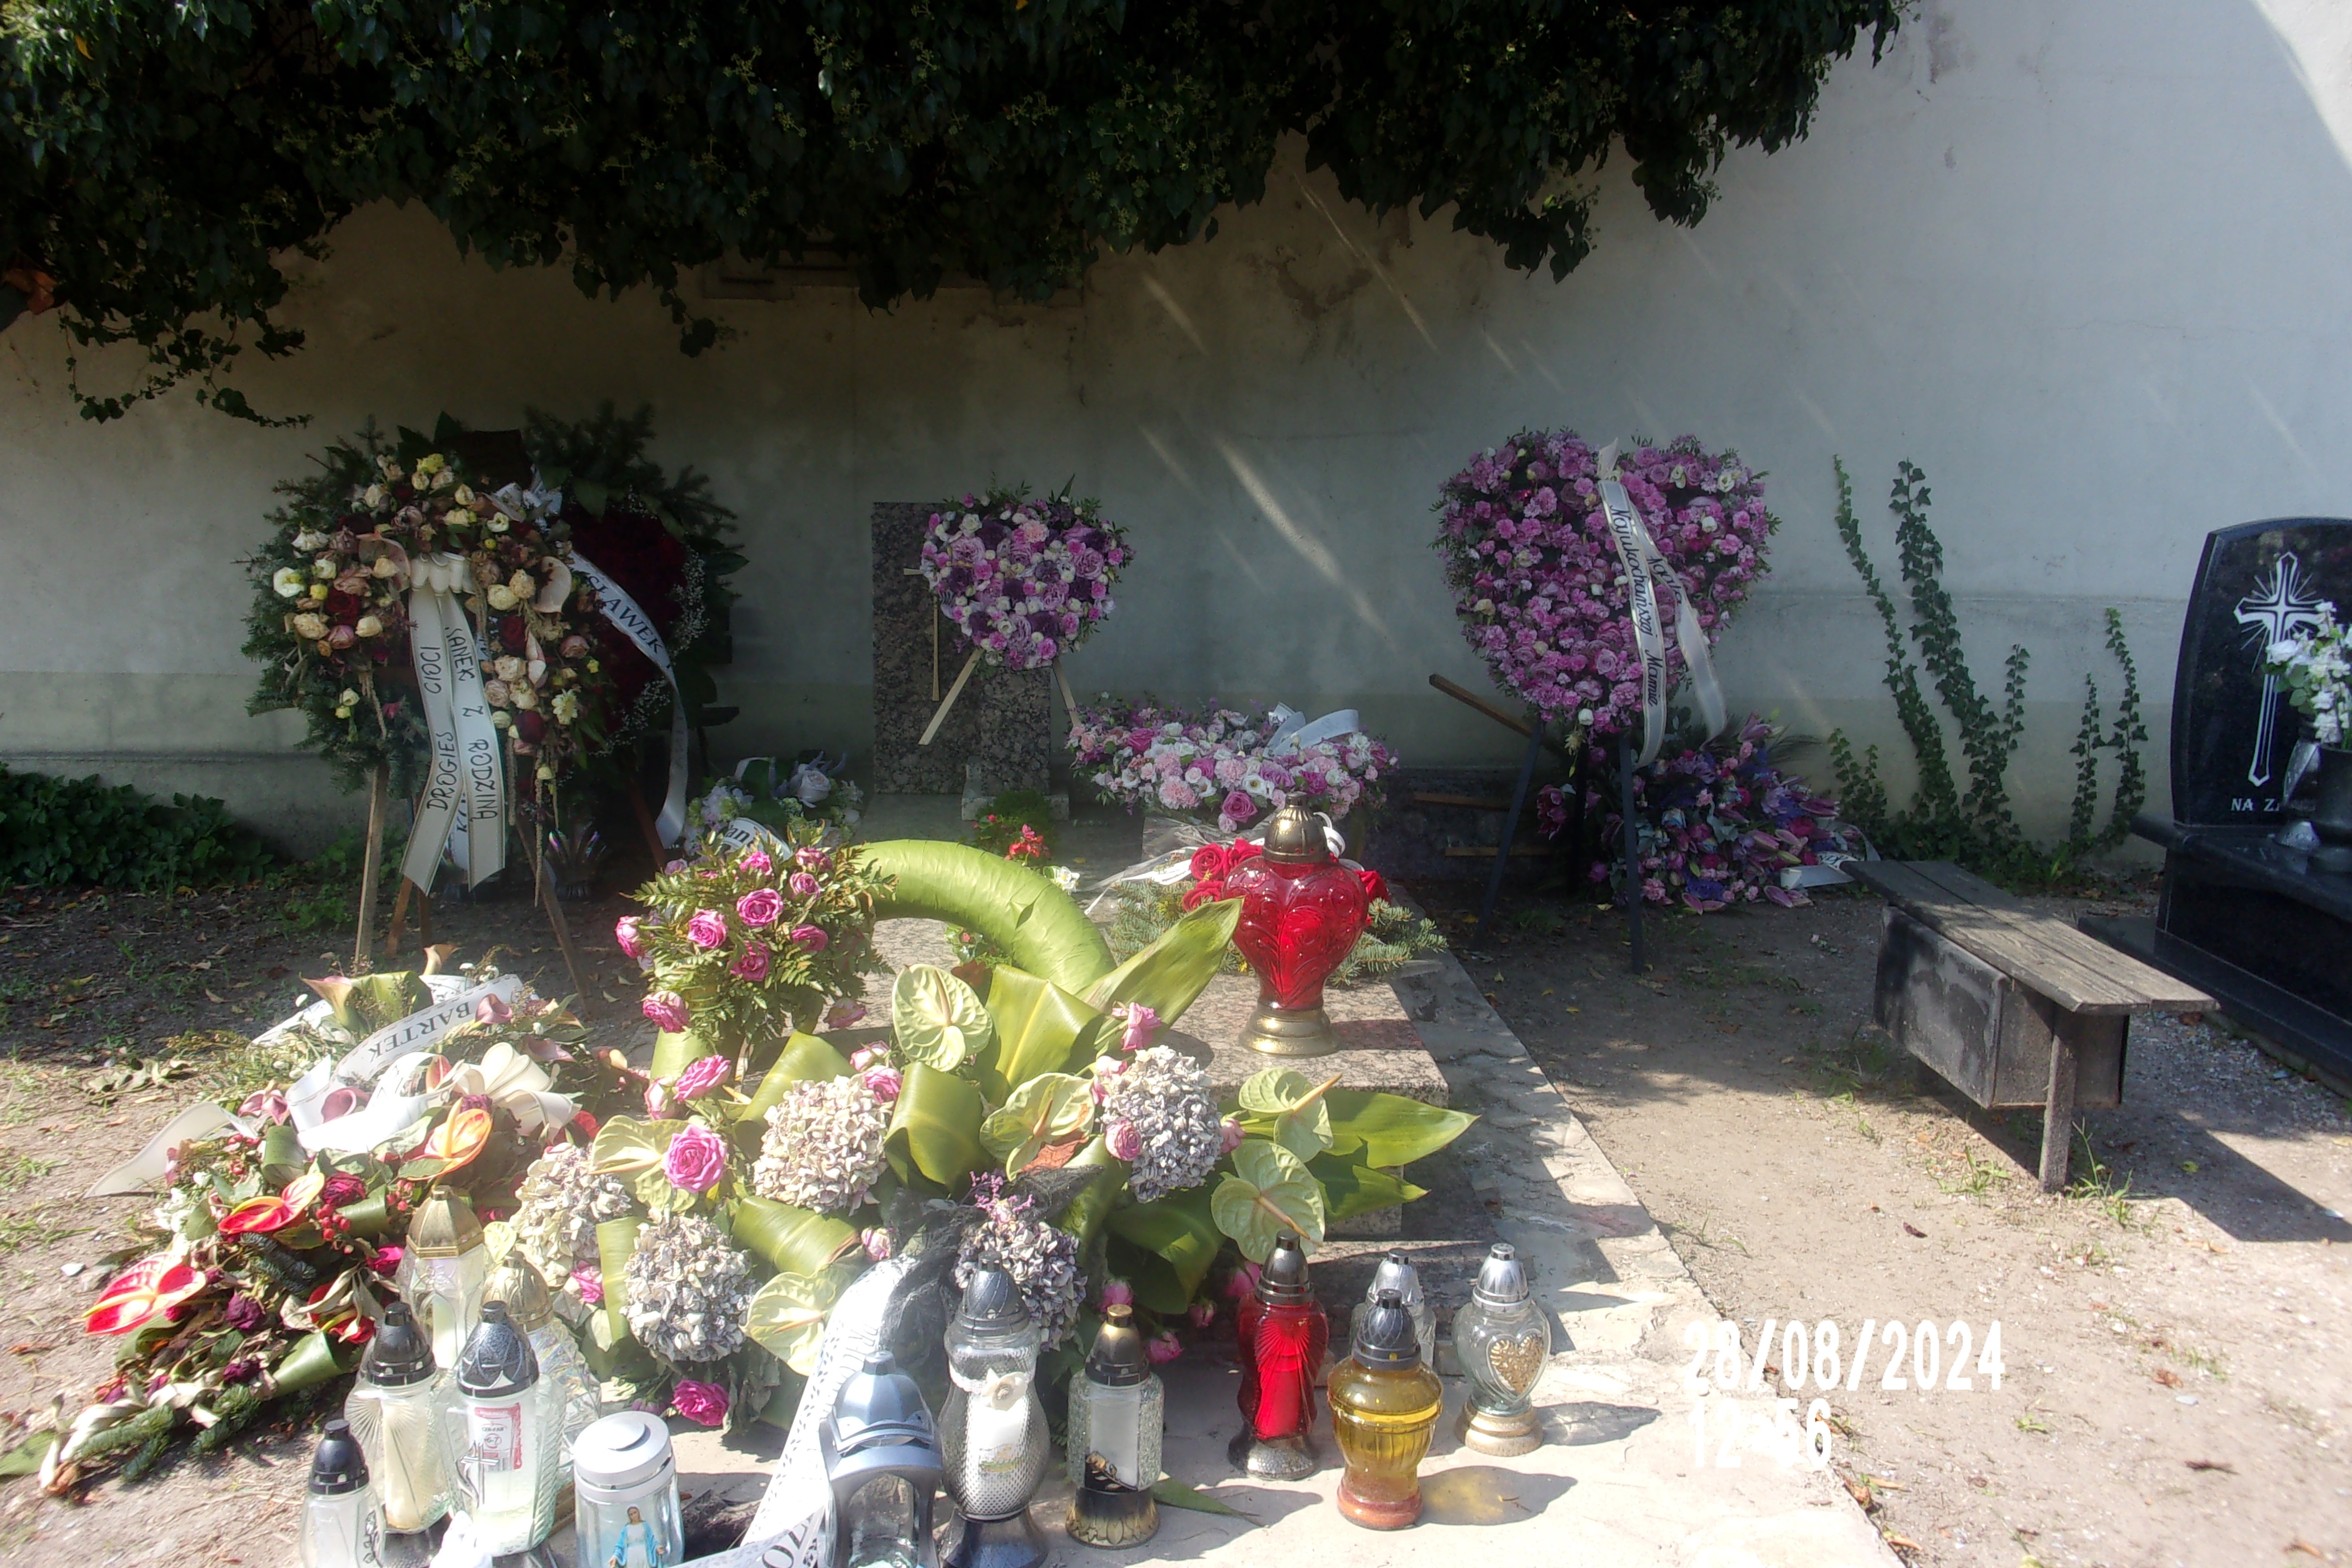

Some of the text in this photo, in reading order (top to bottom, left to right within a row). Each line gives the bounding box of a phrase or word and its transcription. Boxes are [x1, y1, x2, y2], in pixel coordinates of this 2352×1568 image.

[420, 646, 442, 694] CIOCI
[1644, 649, 1663, 707] Mamie
[462, 705, 484, 717] Z
[468, 739, 498, 822] RODZINĄ
[2230, 798, 2253, 812] NA
[368, 1001, 472, 1063] BARTEK
